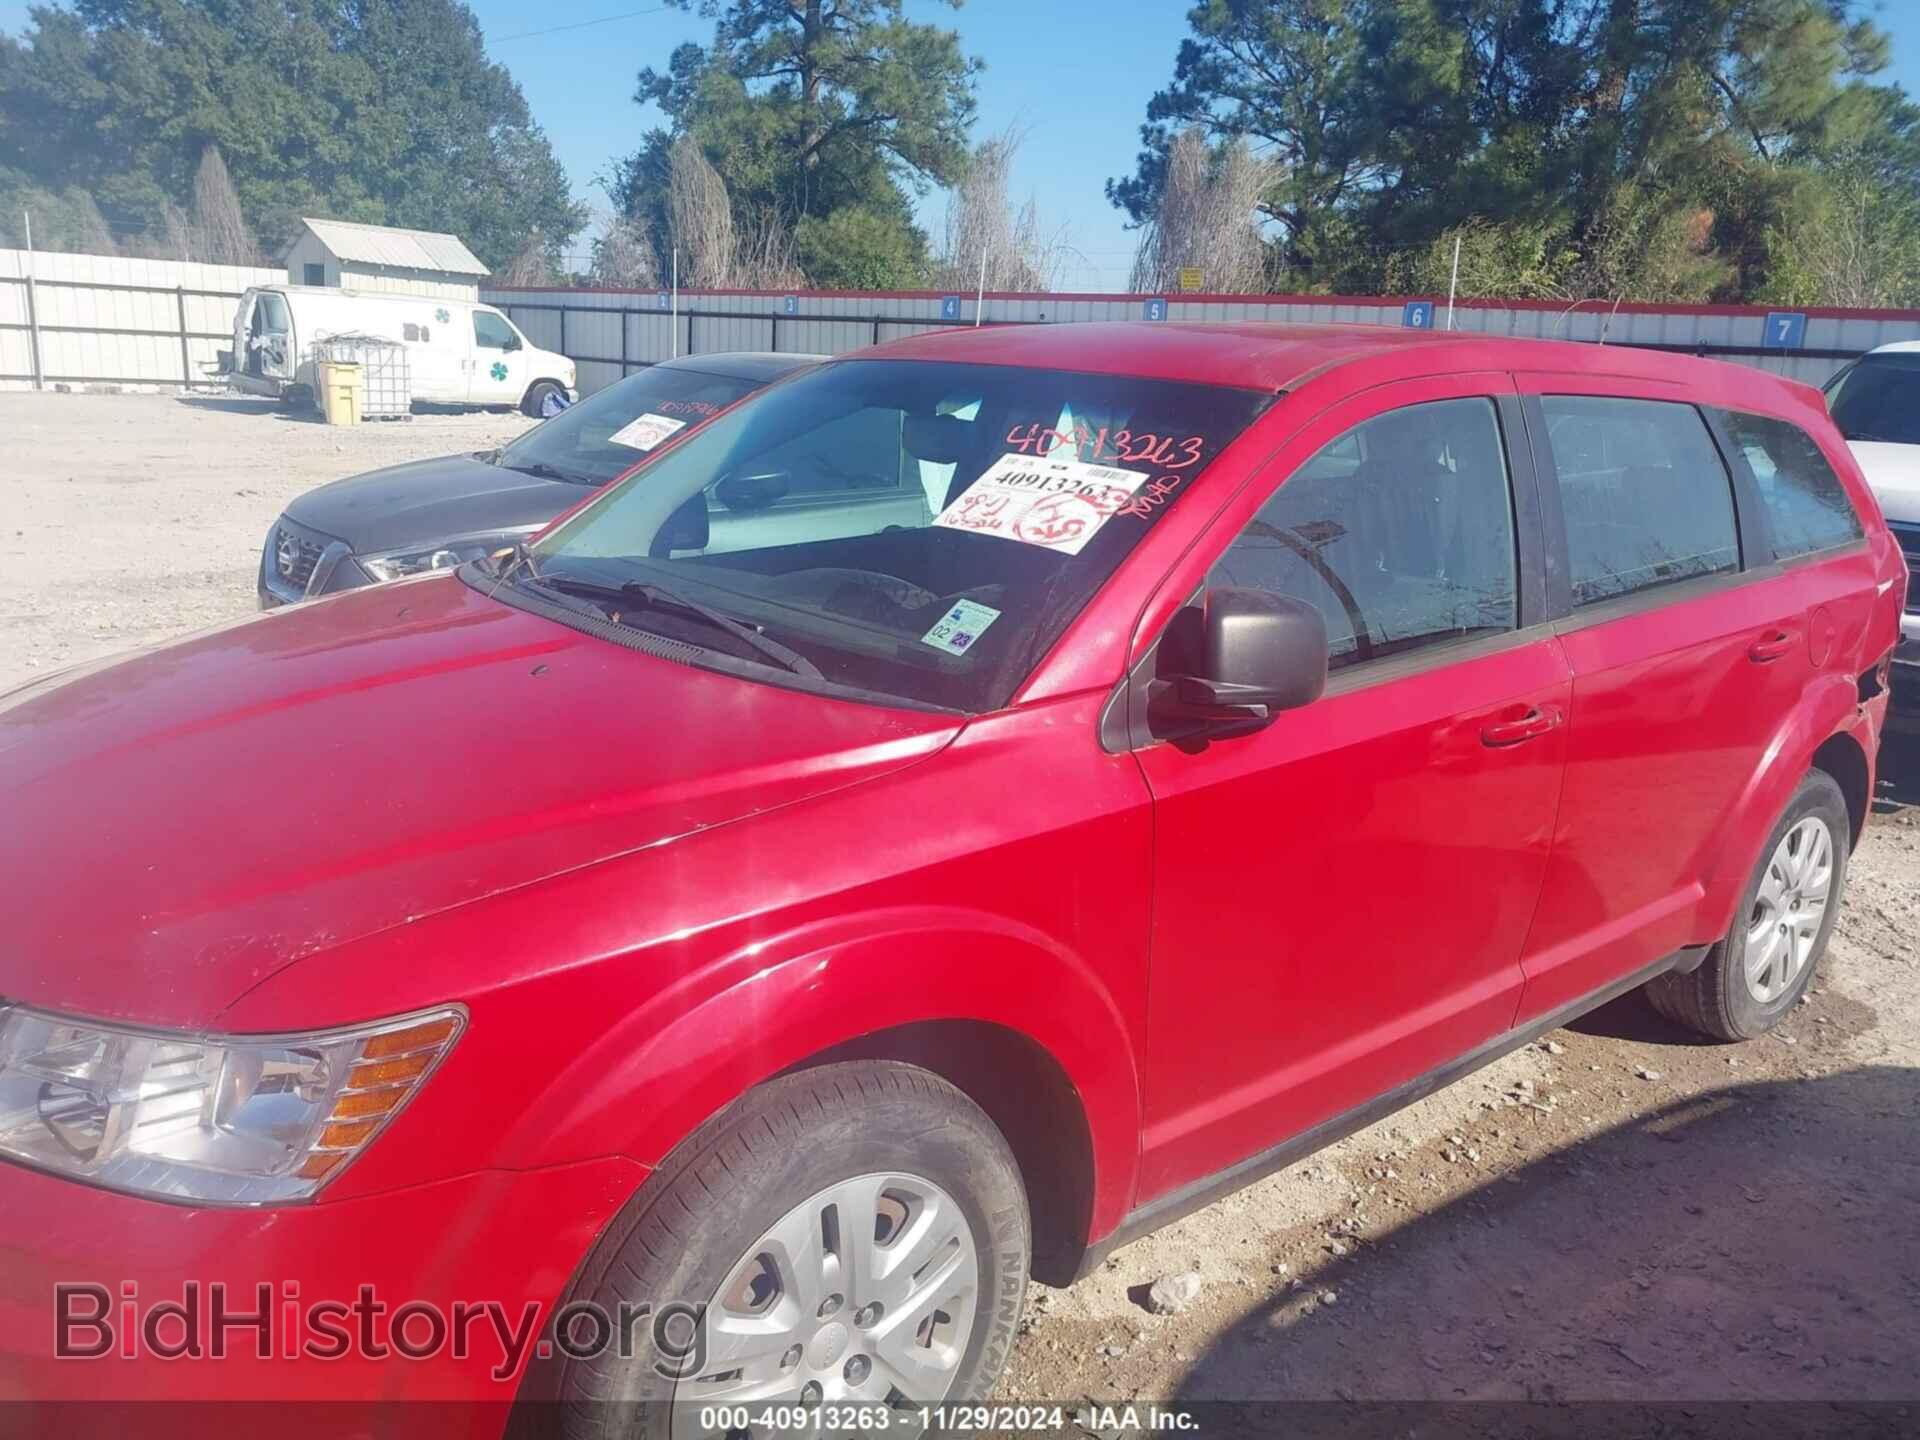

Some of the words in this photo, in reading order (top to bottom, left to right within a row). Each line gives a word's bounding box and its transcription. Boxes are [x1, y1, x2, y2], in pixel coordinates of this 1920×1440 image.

[946, 300, 954, 315] 4
[1150, 304, 1160, 321] 5
[1412, 307, 1424, 327] 6
[1778, 319, 1793, 341] 7
[994, 471, 1113, 501] 40913263
